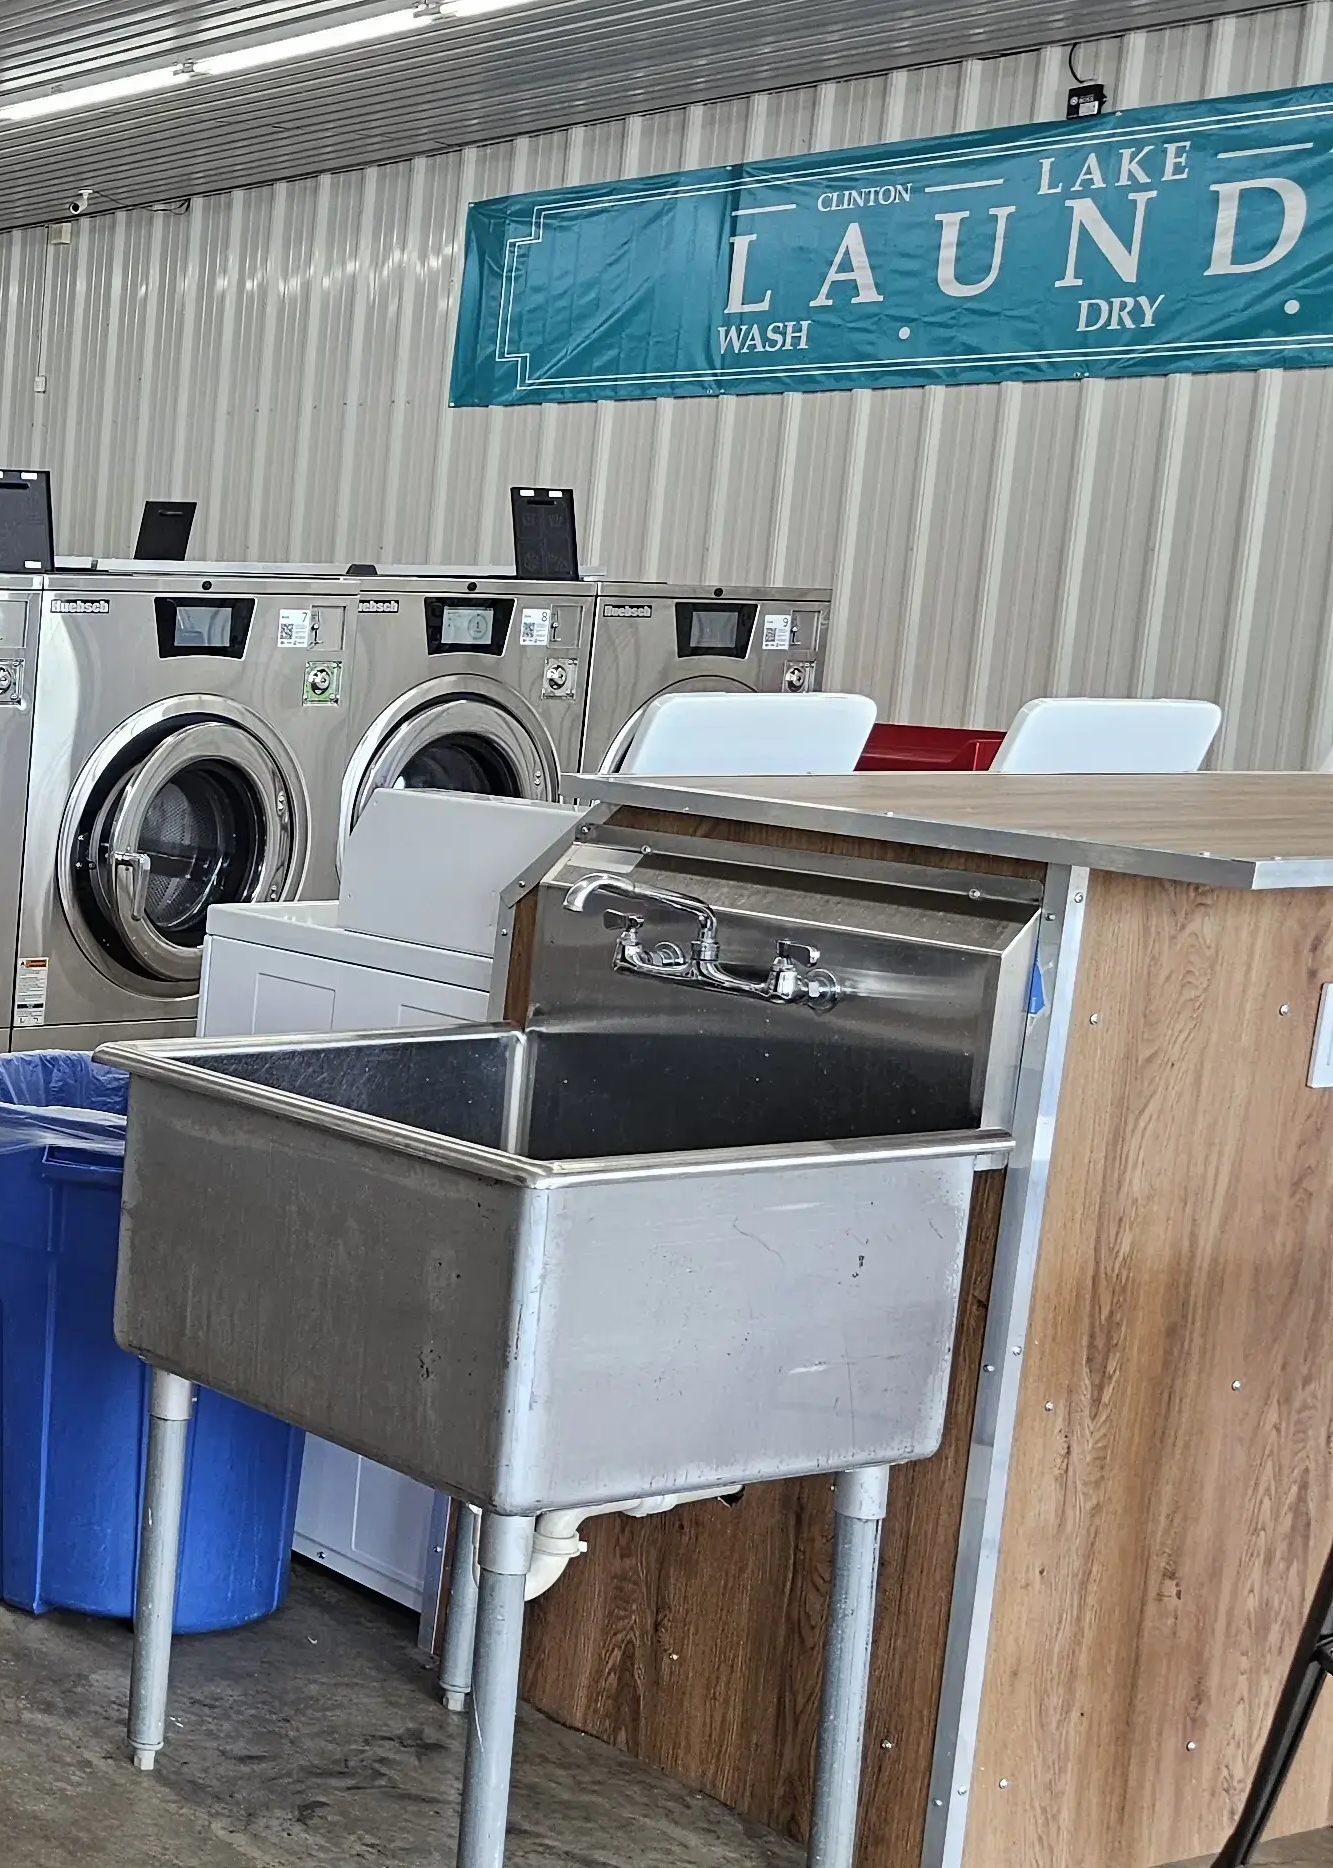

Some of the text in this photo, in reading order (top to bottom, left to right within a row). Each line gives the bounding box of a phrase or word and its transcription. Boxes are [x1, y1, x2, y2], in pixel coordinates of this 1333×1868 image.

[818, 141, 1192, 212] CLINTON LAKE
[718, 294, 1165, 354] WASH DRY
[51, 600, 109, 612] Huebsch
[302, 612, 308, 623] 7
[541, 611, 548, 622] 8
[783, 617, 789, 628] 9
